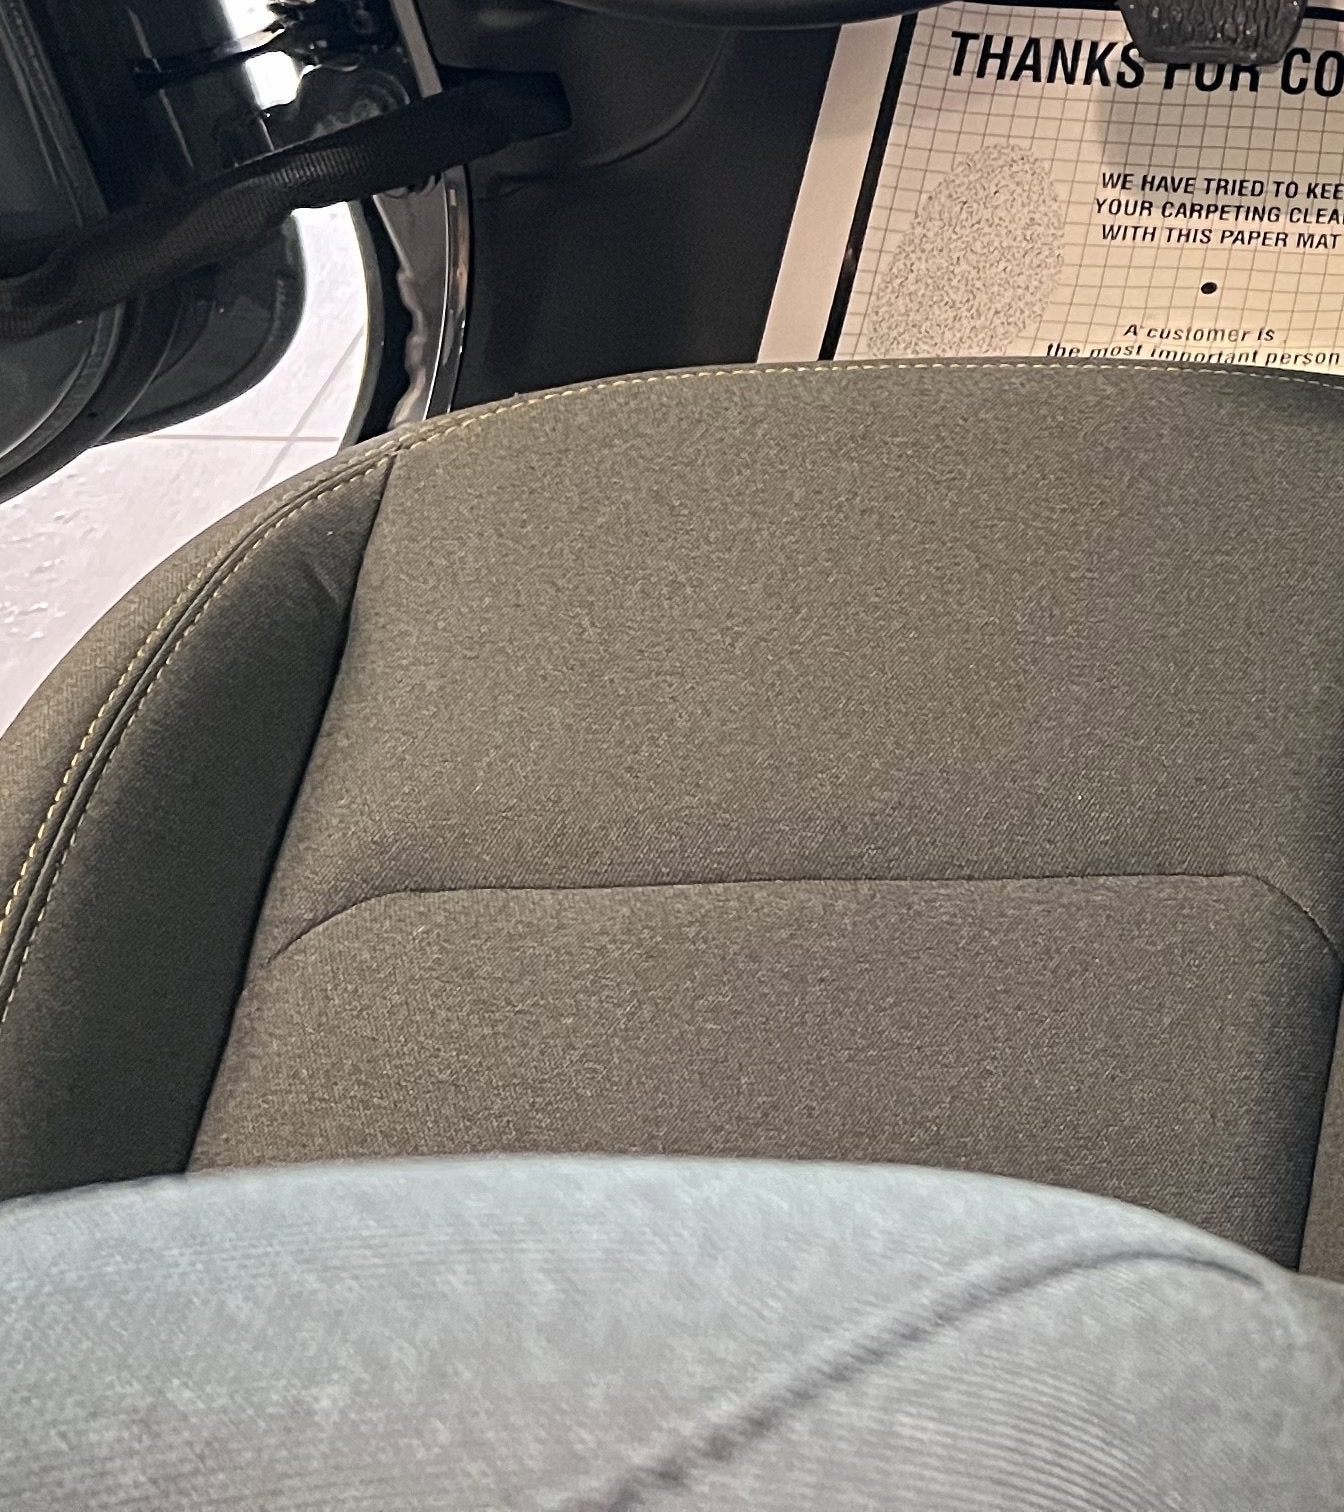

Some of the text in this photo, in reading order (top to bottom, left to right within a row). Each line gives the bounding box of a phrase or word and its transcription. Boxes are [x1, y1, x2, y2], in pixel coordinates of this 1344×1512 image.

[952, 31, 1145, 88] THANKS
[1102, 172, 1135, 191] WE
[1141, 174, 1196, 195] HAVE
[1204, 178, 1264, 198] TRIED
[1273, 181, 1299, 199] TO
[1095, 198, 1153, 217] YOUR
[1161, 201, 1281, 223] CARPETING
[1102, 224, 1342, 249] WITH THIS PAPER MAT
[1123, 324, 1275, 342] A customer is
[1046, 343, 1080, 358] the
[1089, 344, 1143, 358] most
[1265, 350, 1340, 367] person
